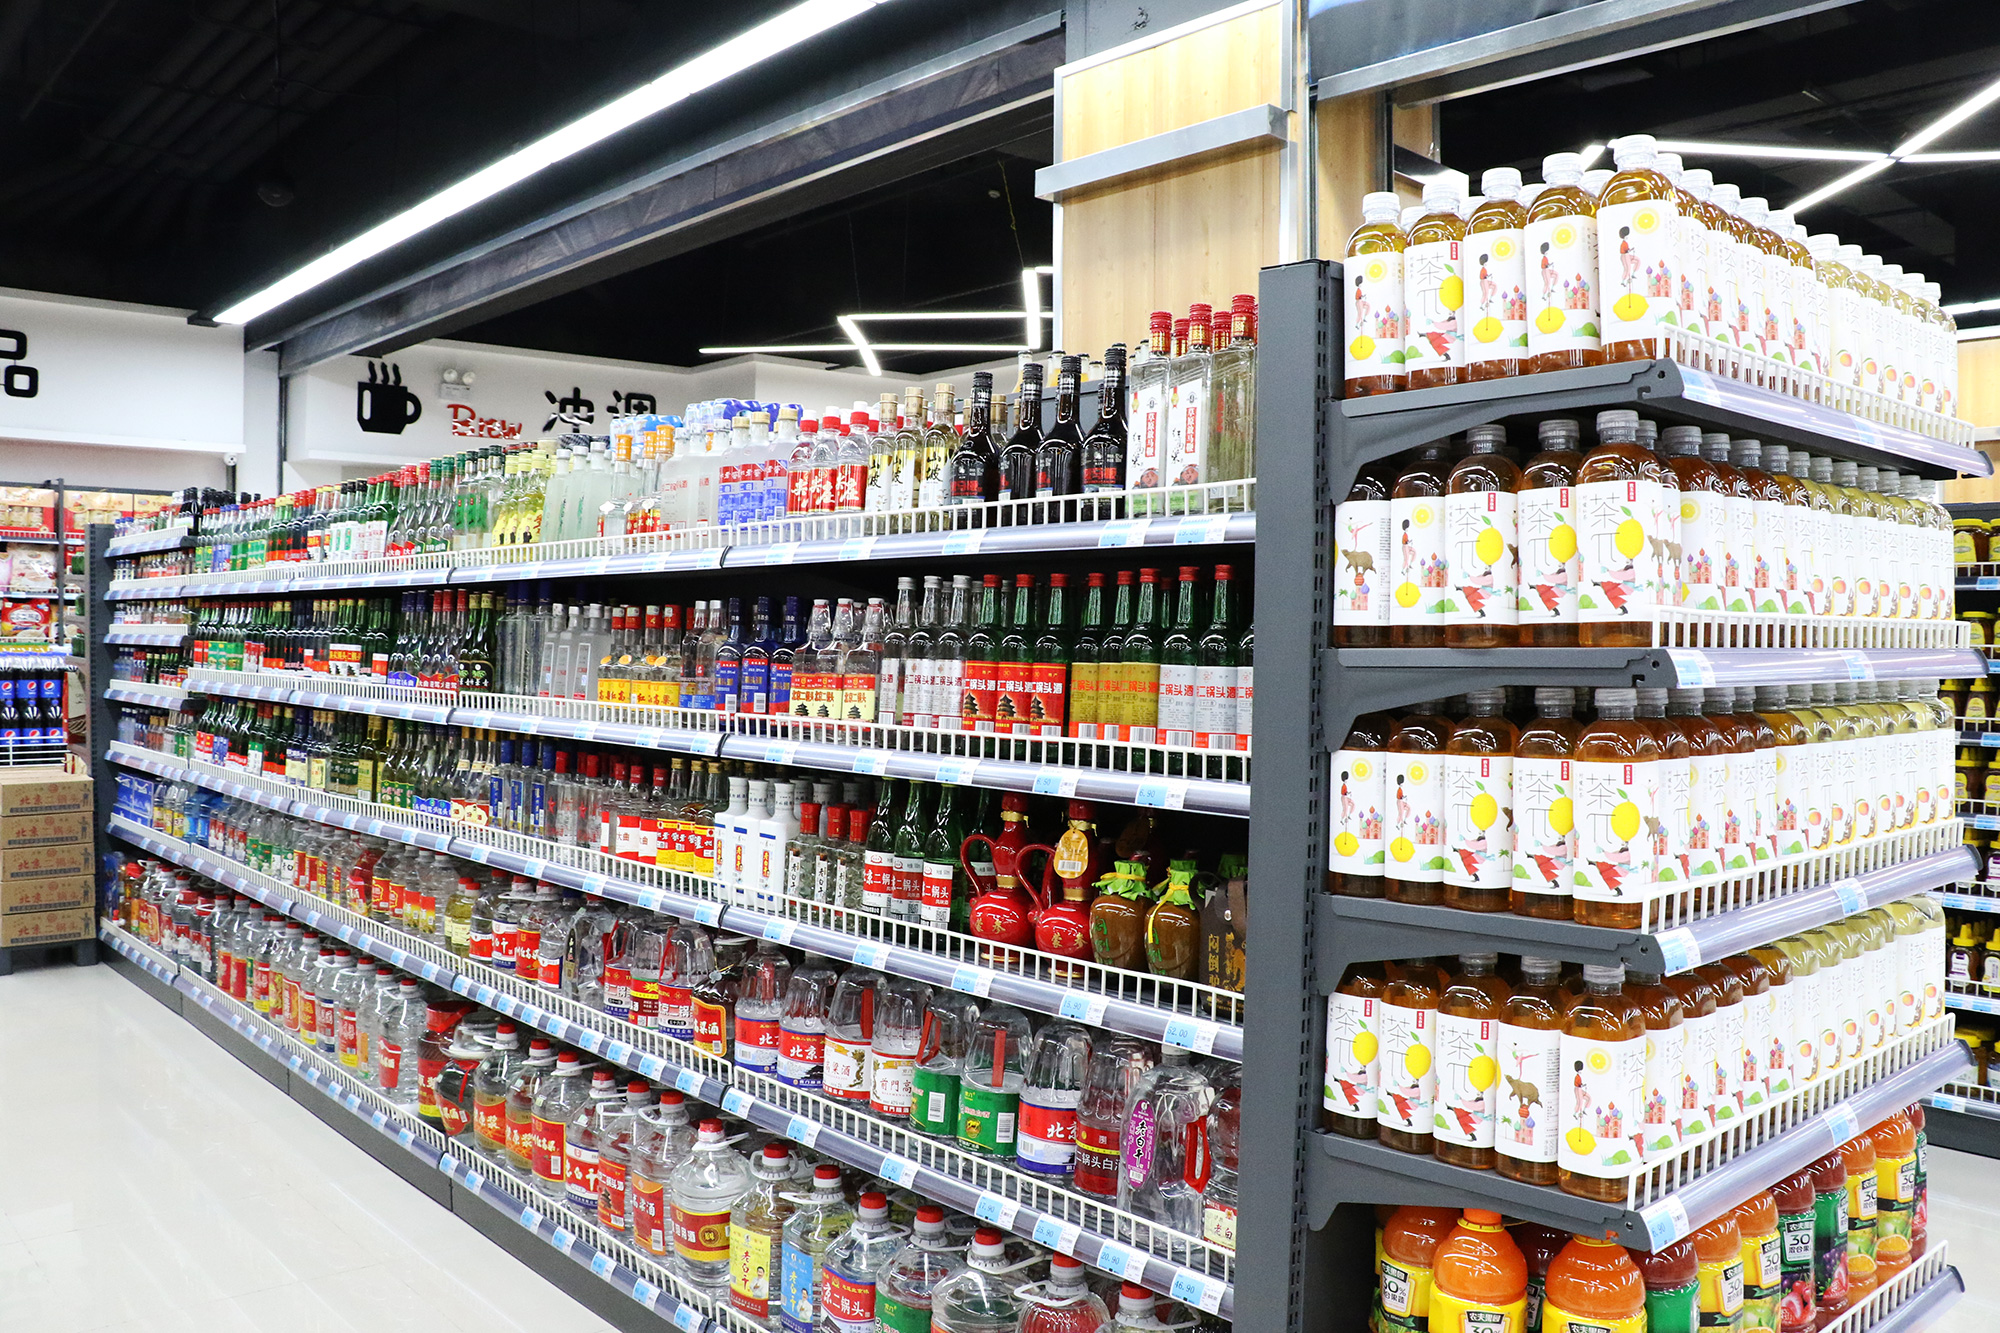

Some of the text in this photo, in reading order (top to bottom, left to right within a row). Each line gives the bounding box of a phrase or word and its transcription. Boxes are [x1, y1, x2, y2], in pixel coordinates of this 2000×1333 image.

[447, 403, 522, 439] Brew
[926, 450, 943, 483] 山坡
[1071, 680, 1098, 692] 二锅头
[1122, 681, 1157, 693] 二锅头酒
[1160, 683, 1194, 697] 二锅头酒
[1197, 686, 1236, 699] 二锅头酒
[1237, 687, 1254, 699] 二锅
[1138, 789, 1156, 798] 6.90
[1063, 999, 1082, 1010] 15.90
[1132, 1120, 1147, 1168] 老白干
[978, 1200, 995, 1213] 17.90
[1036, 1225, 1054, 1238] 25.90
[1213, 1223, 1233, 1240] 老白
[1789, 1233, 1810, 1246] 30
[1100, 1251, 1120, 1266] 20.90
[1174, 1280, 1196, 1295] 46.90
[1383, 1276, 1407, 1296] 30%
[1469, 1312, 1502, 1323] 农夫果园
